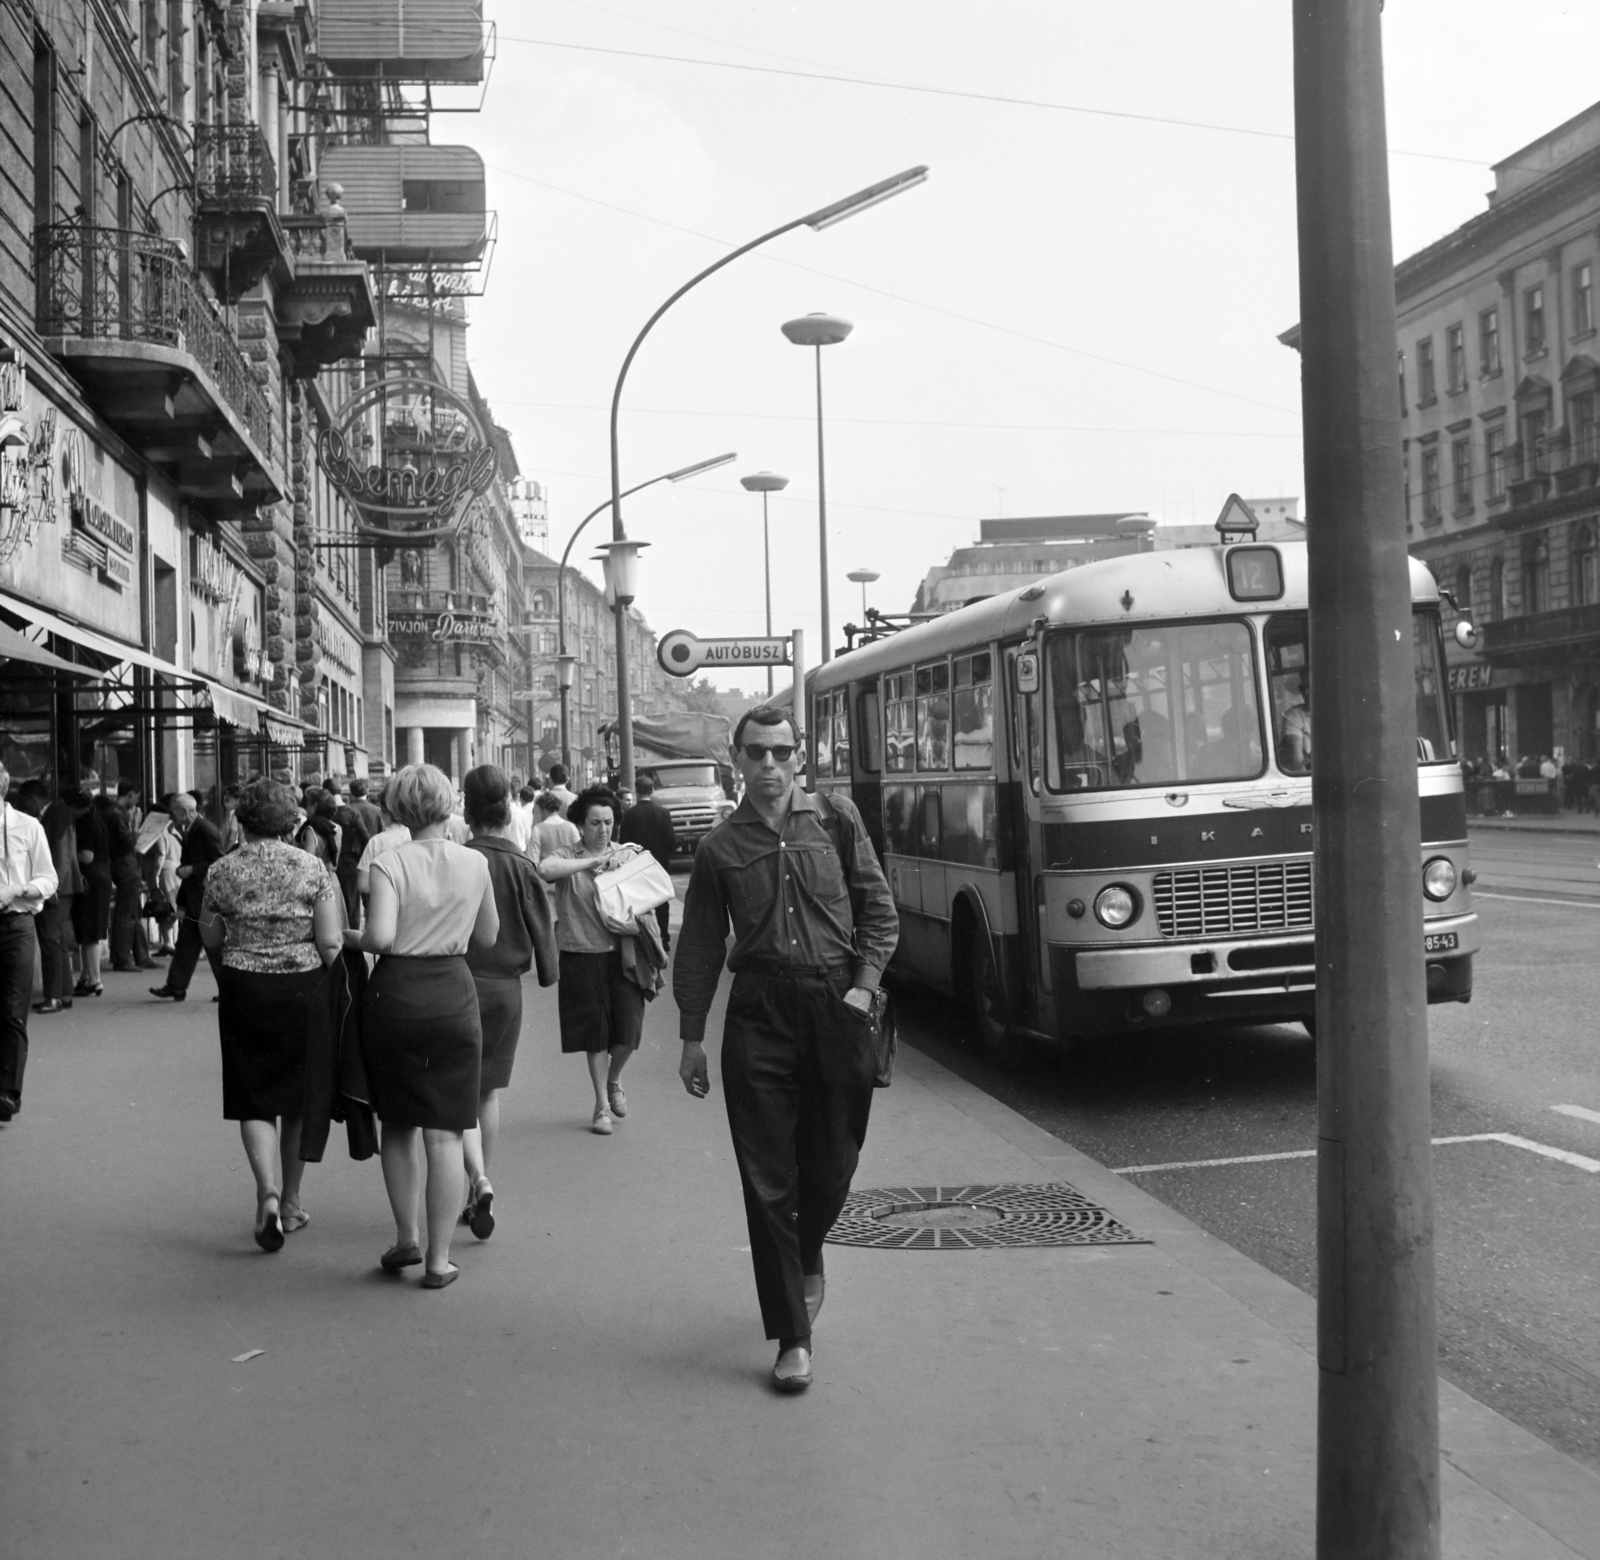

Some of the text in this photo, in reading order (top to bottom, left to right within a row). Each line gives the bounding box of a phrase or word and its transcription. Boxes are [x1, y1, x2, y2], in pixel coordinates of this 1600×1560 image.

[317, 427, 494, 536] Csemege
[1240, 561, 1264, 589] 12
[705, 642, 779, 660] AUTÓBUSZ
